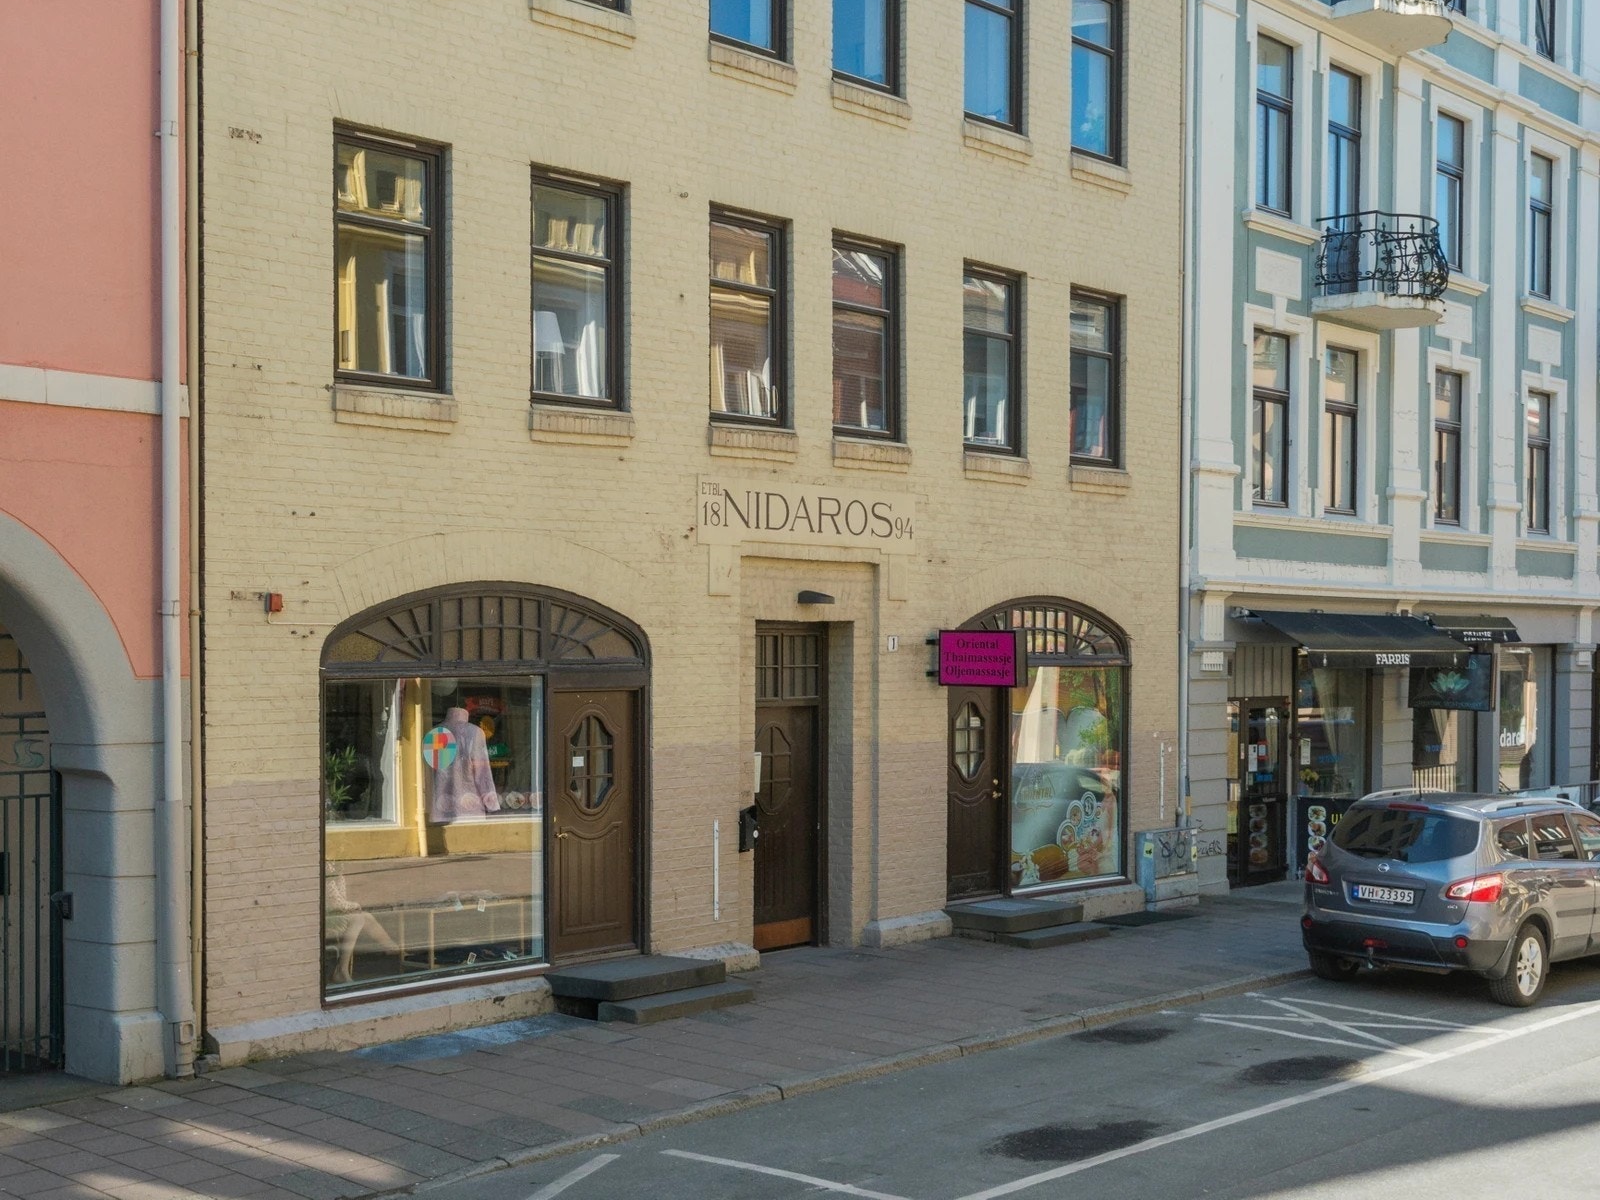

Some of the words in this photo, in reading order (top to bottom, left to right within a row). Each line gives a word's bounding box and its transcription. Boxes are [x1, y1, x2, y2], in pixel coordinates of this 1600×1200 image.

[701, 481, 723, 496] ETBL
[702, 501, 721, 527] 18
[722, 488, 893, 538] NIDAROS
[894, 516, 914, 540] 94
[956, 638, 1000, 650] Oriental
[943, 651, 1012, 666] Thaimassasje
[1375, 653, 1411, 665] FARRIS
[945, 665, 1011, 679] Oljemassasje
[1360, 887, 1375, 898] VH
[1379, 888, 1413, 903] 23395
